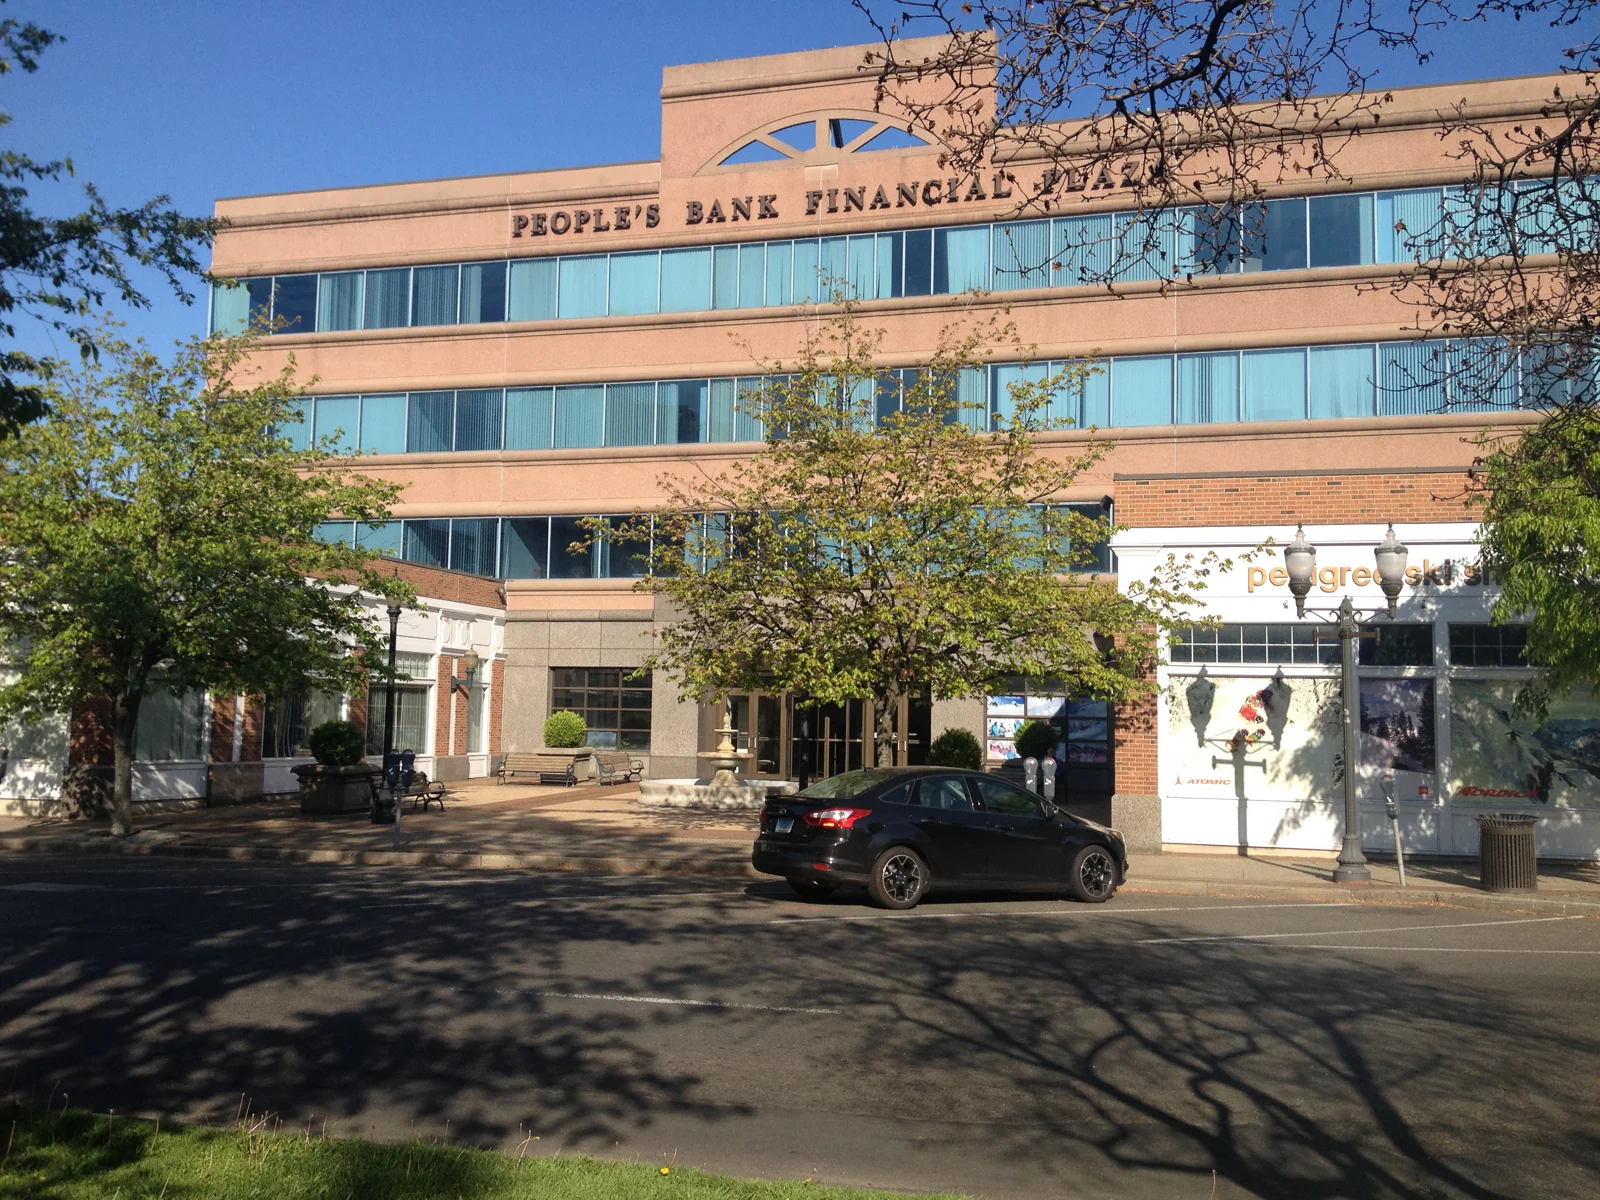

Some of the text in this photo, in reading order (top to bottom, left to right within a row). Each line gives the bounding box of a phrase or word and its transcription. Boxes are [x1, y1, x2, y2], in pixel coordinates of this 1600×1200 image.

[512, 158, 1167, 238] PEOPLE'S BANK FINANCIAL PLAZ
[1405, 559, 1451, 586] ski
[1186, 778, 1232, 786] ATOMIC
